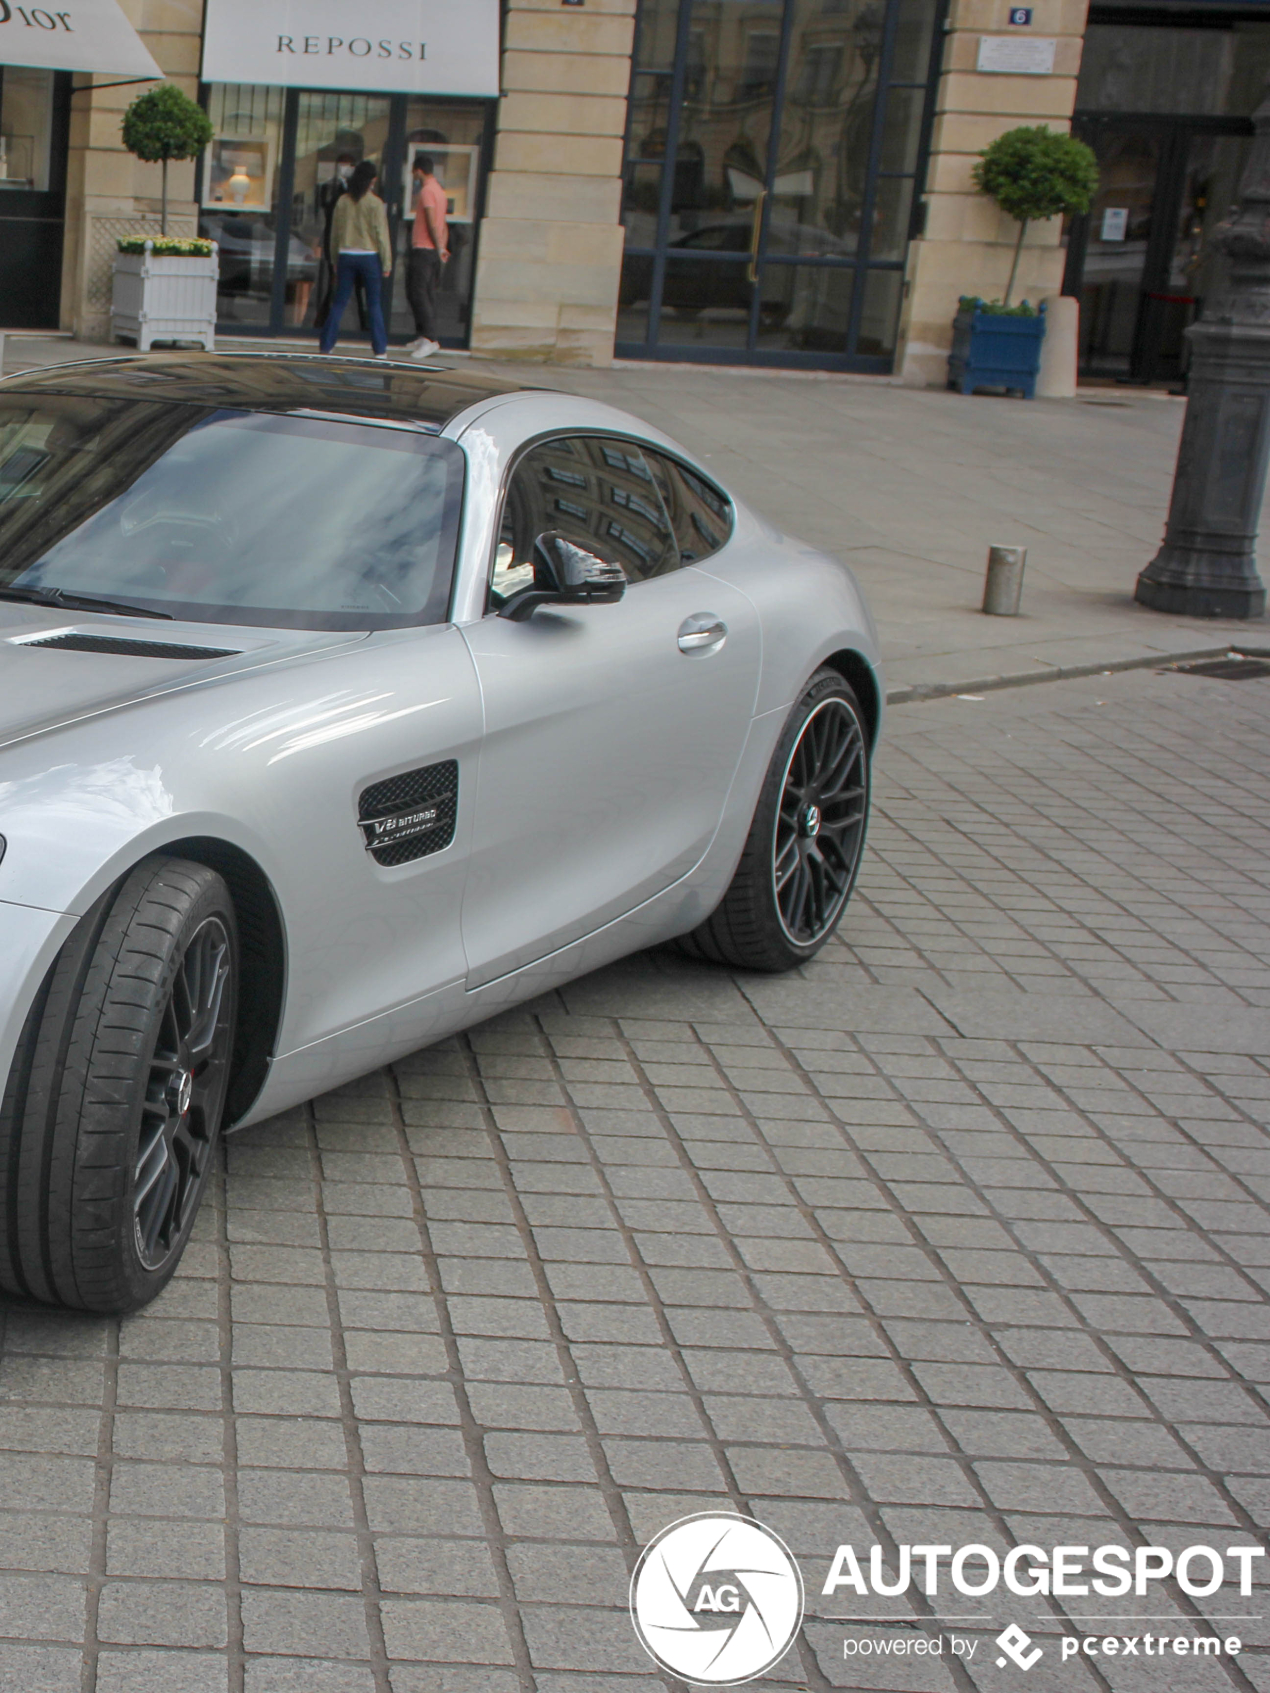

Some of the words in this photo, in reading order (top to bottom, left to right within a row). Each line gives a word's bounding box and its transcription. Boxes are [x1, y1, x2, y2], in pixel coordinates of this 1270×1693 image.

[1014, 9, 1027, 25] 6
[276, 34, 428, 61] REPOSSI
[374, 818, 397, 834] V8
[398, 809, 436, 828] BITURBO
